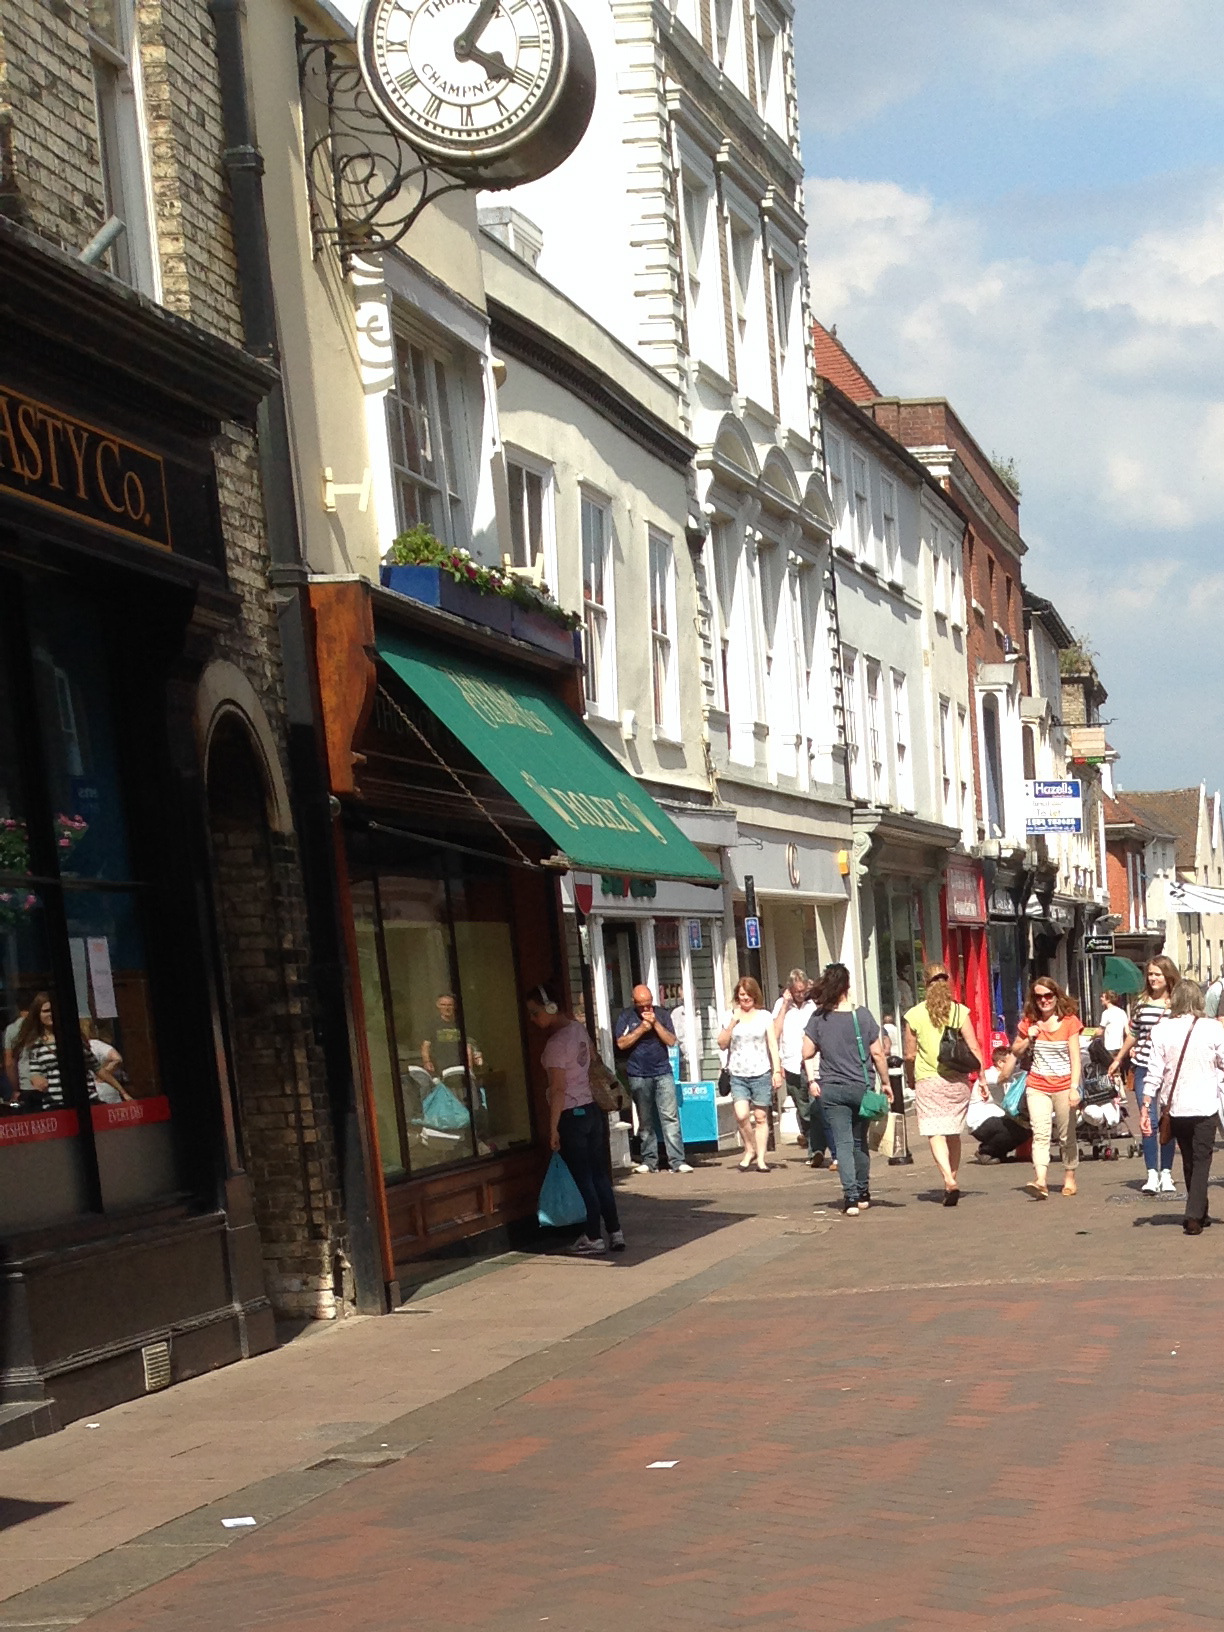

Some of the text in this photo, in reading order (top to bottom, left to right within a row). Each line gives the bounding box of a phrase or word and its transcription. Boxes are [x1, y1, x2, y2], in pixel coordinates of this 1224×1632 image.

[421, 63, 498, 98] CHAMPNE
[1035, 782, 1073, 796] Hazells
[550, 787, 641, 834] ROLEX
[0, 1120, 30, 1140] RESHLY
